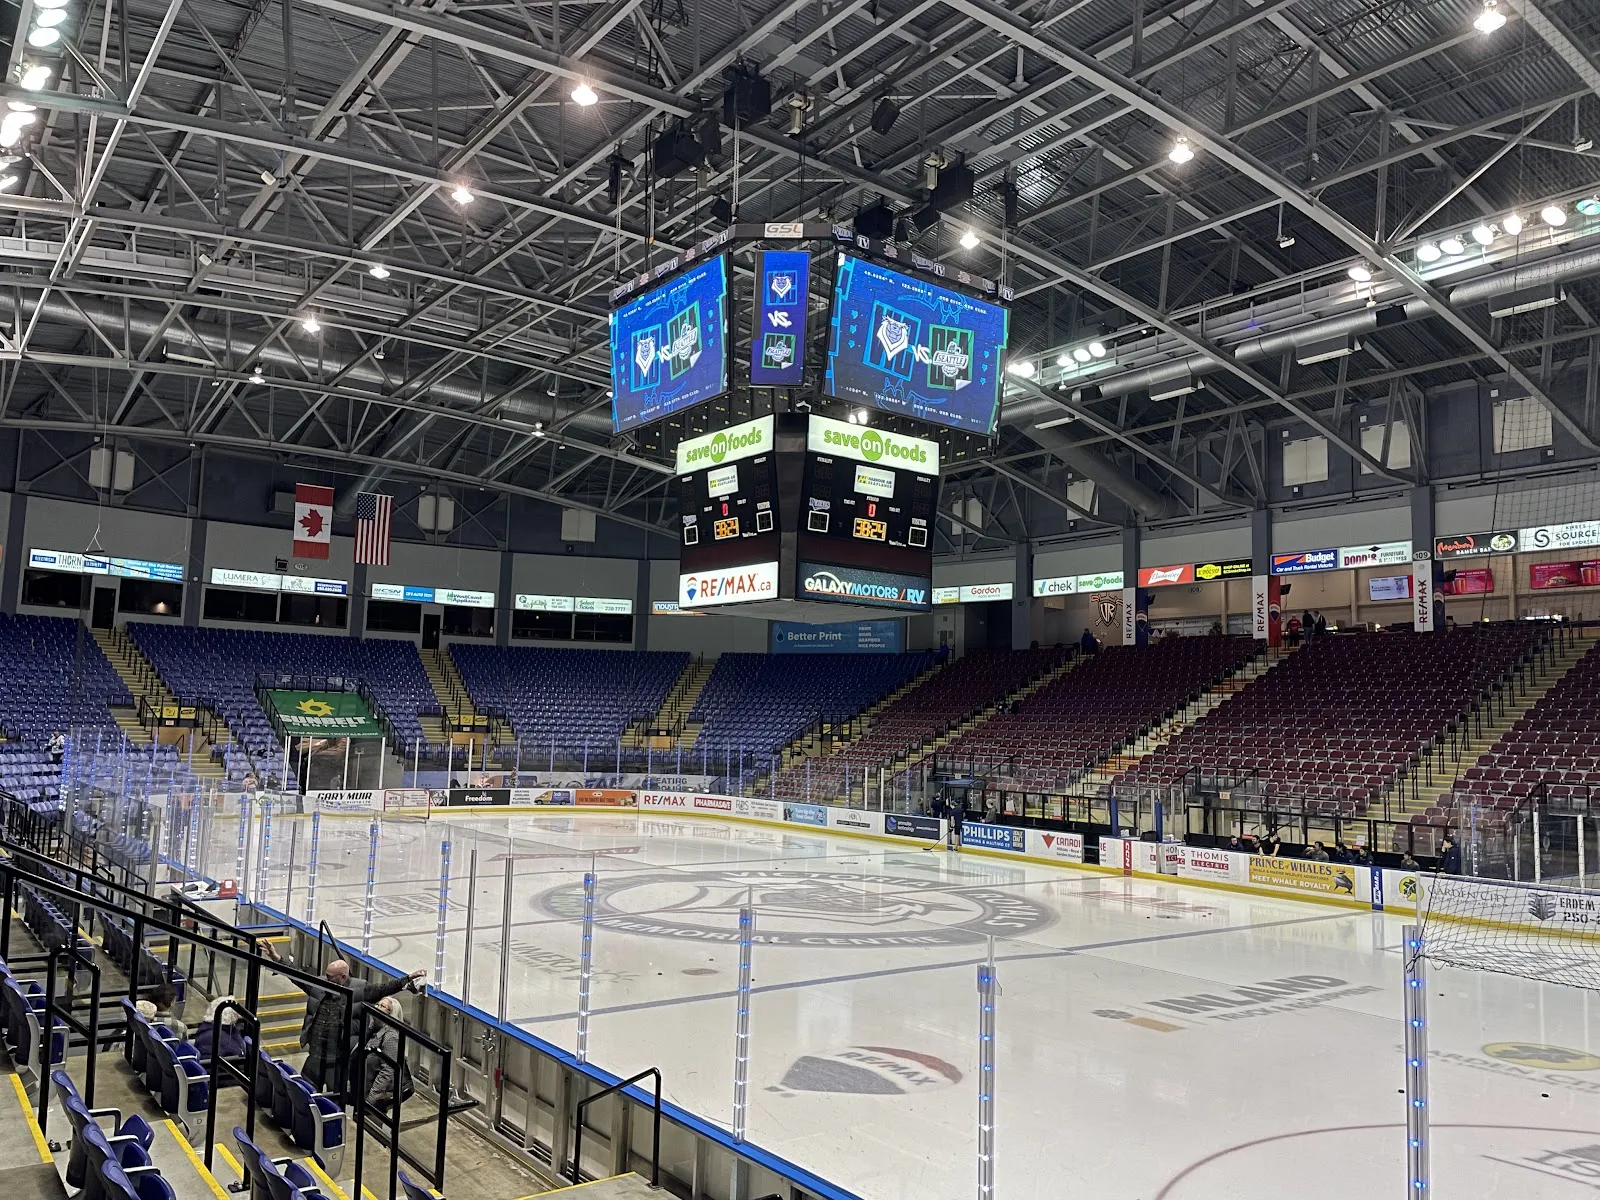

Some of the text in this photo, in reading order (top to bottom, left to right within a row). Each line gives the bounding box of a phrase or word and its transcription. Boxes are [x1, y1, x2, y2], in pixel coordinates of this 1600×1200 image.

[766, 224, 801, 234] GSL
[936, 354, 966, 367] SEATTLE
[686, 427, 762, 463] save on foods
[824, 430, 927, 463] save on foods
[868, 504, 876, 517] 0
[856, 520, 886, 539] 38:24
[1556, 530, 1597, 541] SOURCE
[1305, 552, 1335, 563] Budget
[223, 573, 259, 582] LUMERA
[1103, 576, 1122, 584] foods
[701, 573, 771, 597] RE/MAX.ca
[971, 586, 1001, 595] Gordon
[1048, 580, 1072, 592] chek
[906, 589, 925, 604] RV
[1419, 579, 1428, 624] RE/MAX
[787, 631, 842, 641] Better Print
[277, 714, 366, 724] SUNBELT
[347, 792, 372, 800] MUIR
[644, 795, 685, 806] RE/MAX
[695, 800, 731, 810] PHARMASAVE
[962, 825, 1010, 841] PHILLIPS
[1191, 850, 1229, 862] THOMIS
[1192, 860, 1228, 870] ELECTRIC
[1250, 857, 1284, 870] PRINCE
[1290, 861, 1332, 876] WHALES
[1252, 875, 1331, 891] MEET WHALE ROYALTY
[1560, 897, 1596, 912] ERDEM
[800, 936, 949, 945] CENTRE
[1145, 974, 1349, 1014] INLAND
[1396, 1044, 1533, 1075] ARDEN
[835, 1052, 936, 1086] RE/MAX
